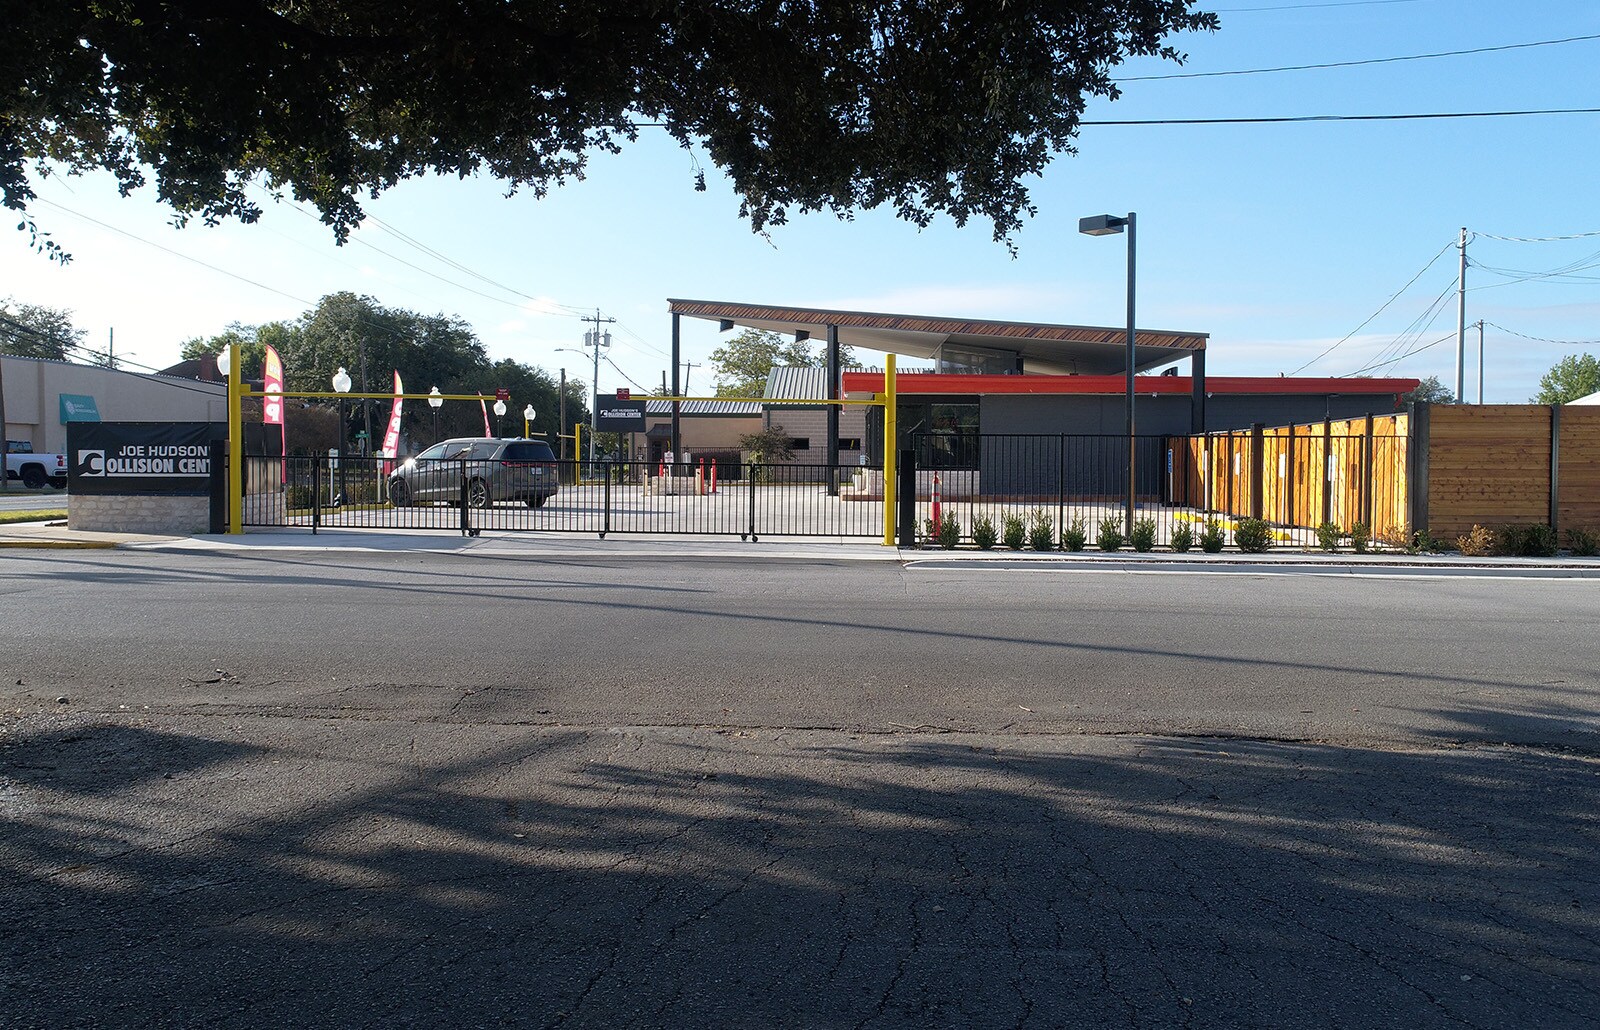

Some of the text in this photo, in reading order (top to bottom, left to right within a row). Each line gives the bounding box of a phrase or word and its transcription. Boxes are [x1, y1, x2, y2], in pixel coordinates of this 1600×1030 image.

[119, 445, 211, 457] JOE HUDSON'
[178, 458, 211, 473] CENT
